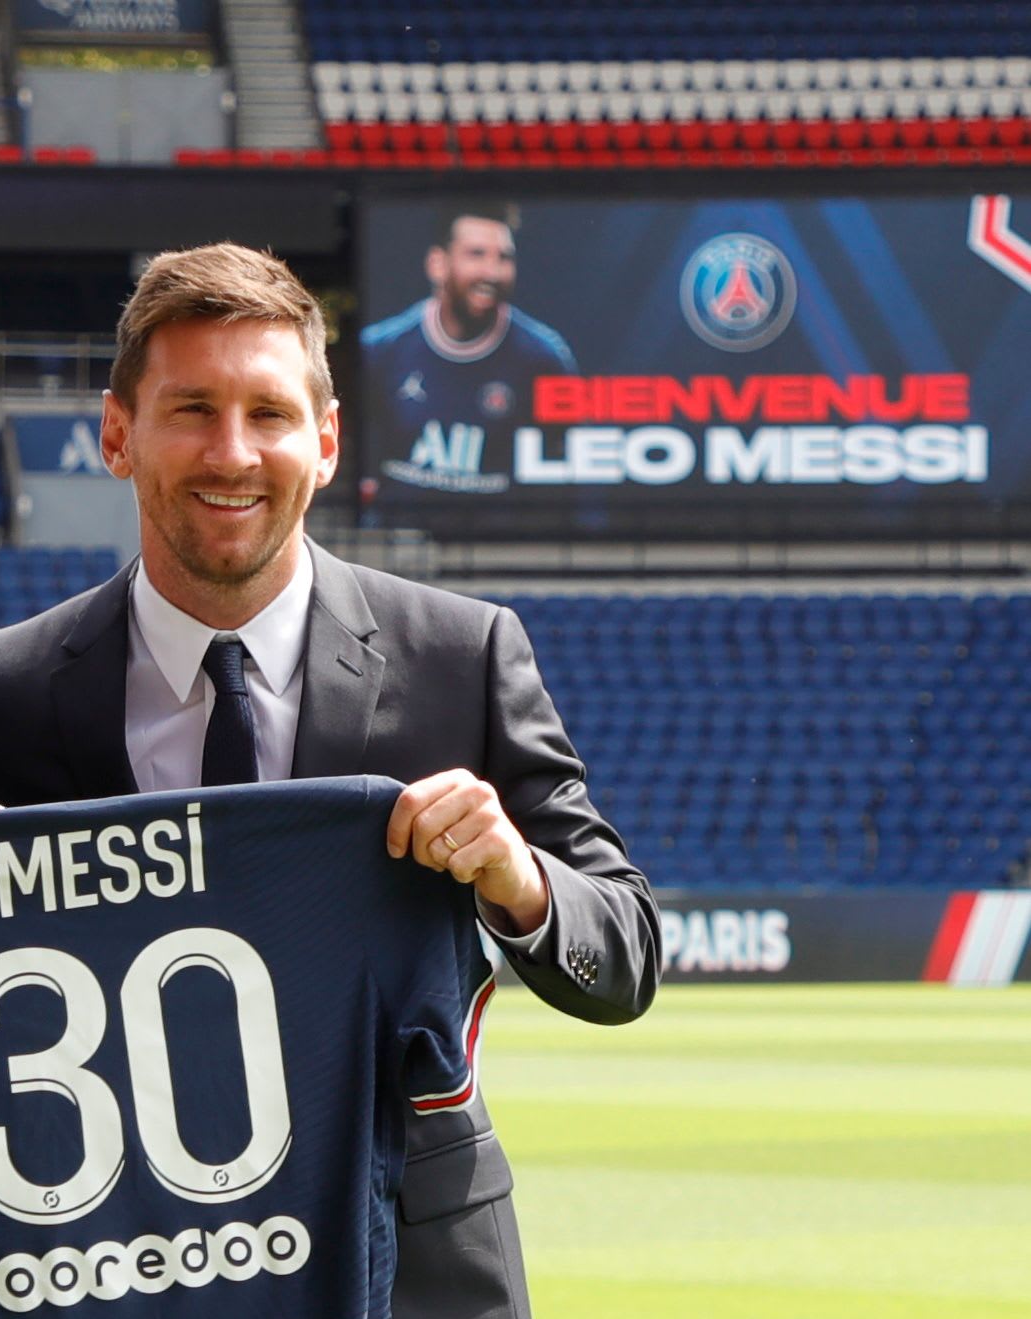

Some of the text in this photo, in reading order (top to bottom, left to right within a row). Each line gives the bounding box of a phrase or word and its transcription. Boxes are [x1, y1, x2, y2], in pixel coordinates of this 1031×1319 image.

[534, 374, 969, 422] BIENVENUE
[515, 425, 696, 484] LEO
[704, 424, 988, 484] MESSI
[660, 908, 792, 973] PARIS
[4, 1227, 298, 1298] ooredoo
